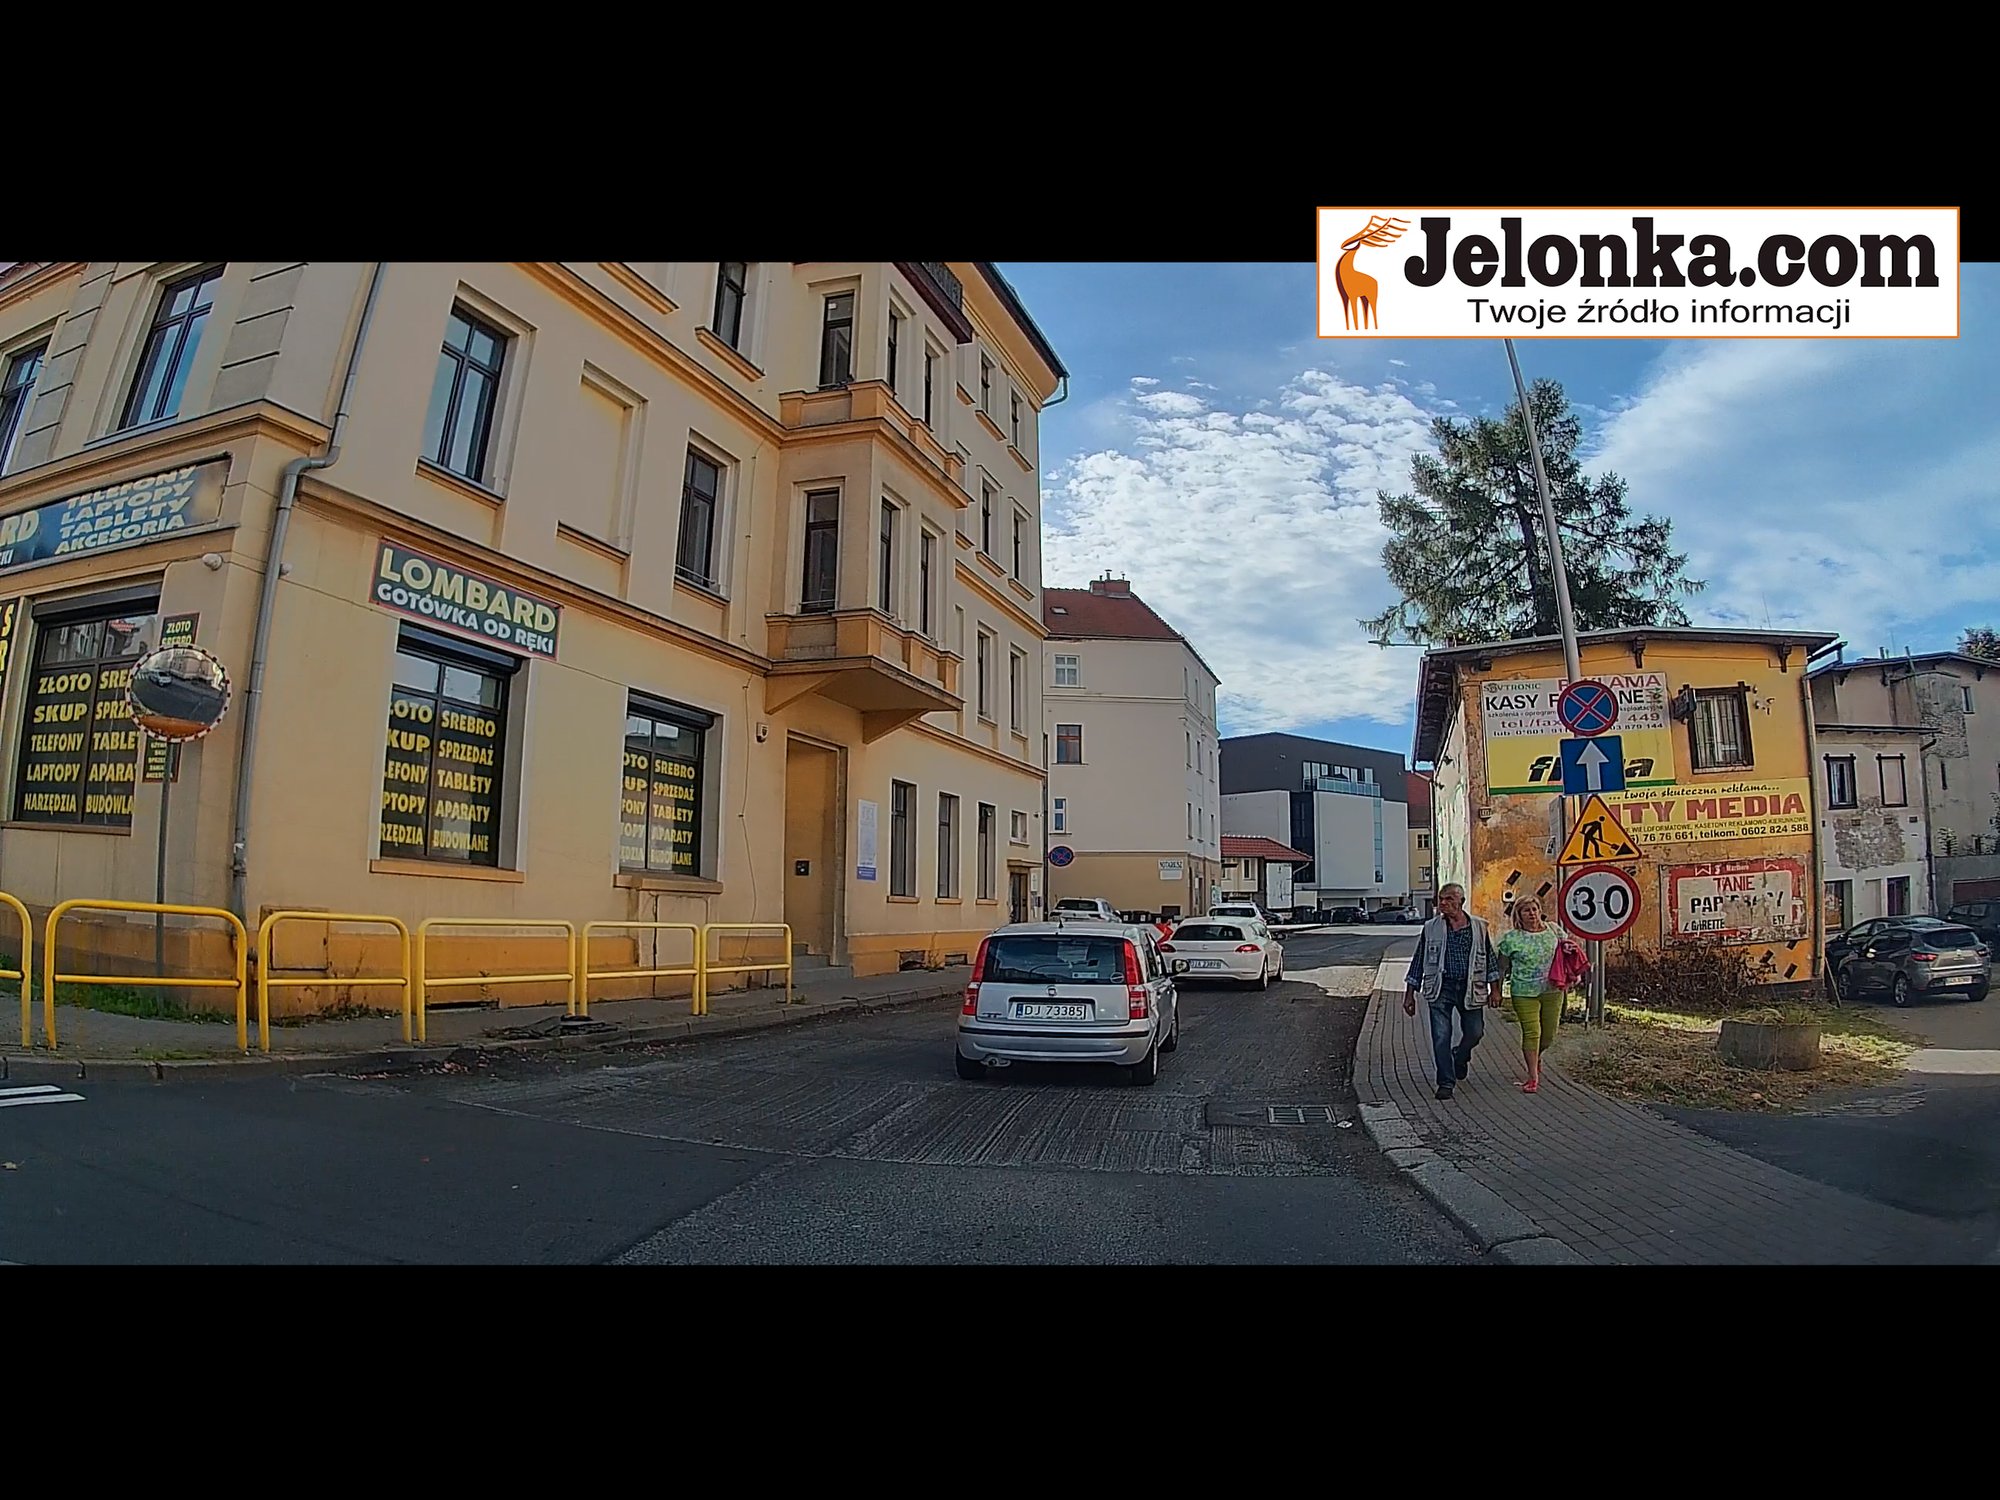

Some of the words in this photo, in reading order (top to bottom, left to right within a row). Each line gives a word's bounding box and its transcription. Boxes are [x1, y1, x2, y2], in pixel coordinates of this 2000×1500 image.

[67, 466, 196, 509] TELEFONY
[61, 480, 194, 525] LAPTOPY
[0, 510, 39, 547] RD
[60, 497, 191, 538] TABLETY
[55, 515, 185, 555] AKCESORIA
[380, 547, 556, 633] LOMBARD
[377, 583, 478, 630] GOTÓWKA
[484, 619, 511, 639] OD
[515, 630, 554, 654] RĘKI
[38, 673, 92, 694] ZŁOTO
[100, 669, 128, 689] SRE
[33, 703, 88, 724] SKUP
[1486, 694, 1538, 711] KASY
[390, 699, 433, 723] OTO
[441, 710, 496, 738] SREBRO
[1628, 713, 1660, 722] 449
[31, 732, 84, 752] TELEFONY
[439, 738, 494, 766] SPRZEDAŻ
[26, 763, 81, 782] LAPTOPY
[89, 762, 137, 782] APARA
[384, 760, 428, 784] EFONY
[437, 769, 492, 794] TABLETY
[654, 759, 695, 780] SREBRO
[653, 781, 695, 801] SPRZEDAŻ
[1624, 788, 1657, 799] Twoja
[1661, 787, 1717, 798] skuteczna
[24, 792, 77, 815] NARZĘDZIA
[435, 799, 490, 823] APARATY
[653, 804, 693, 822] TABLETY
[1608, 800, 1676, 824] ITY
[1686, 793, 1805, 820] MEDIA
[433, 829, 489, 852] BUDOWLANE
[651, 826, 693, 844] APARATY
[1643, 833, 1656, 842] 76
[1660, 832, 1672, 841] 76
[1700, 829, 1739, 838] telkom.
[1741, 827, 1766, 836] 0602
[1769, 825, 1788, 834] 824
[1791, 823, 1809, 832] 588
[1713, 876, 1755, 892] TANIE
[1571, 885, 1629, 921] 30
[1024, 1005, 1041, 1015] DJ
[1046, 1006, 1083, 1016] 73385
